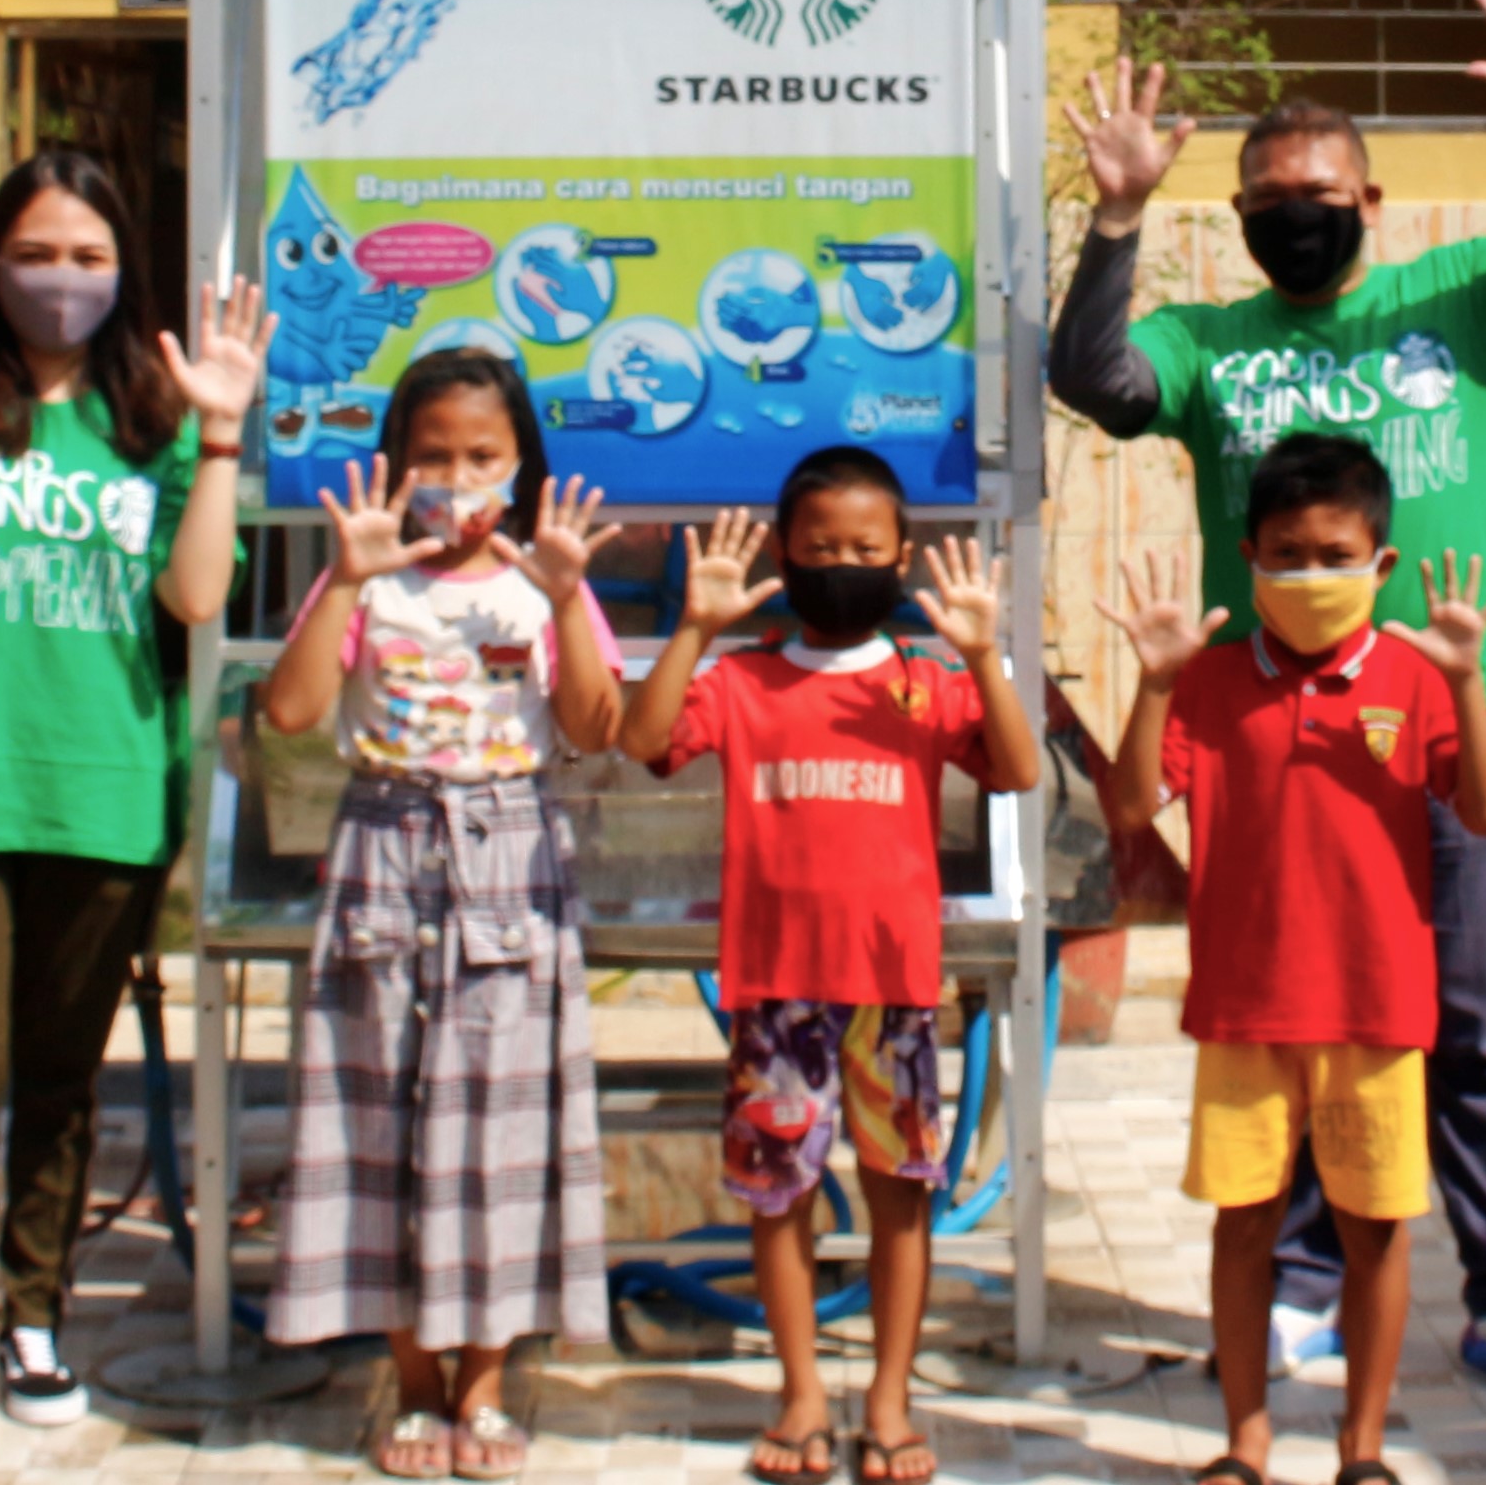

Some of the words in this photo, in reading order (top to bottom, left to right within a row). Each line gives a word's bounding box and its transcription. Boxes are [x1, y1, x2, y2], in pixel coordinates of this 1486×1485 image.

[657, 76, 929, 103] STARBUCKS
[356, 174, 544, 206] Bagaimana
[555, 178, 631, 200] cara
[641, 173, 786, 198] mencuci
[795, 174, 912, 205] tangan
